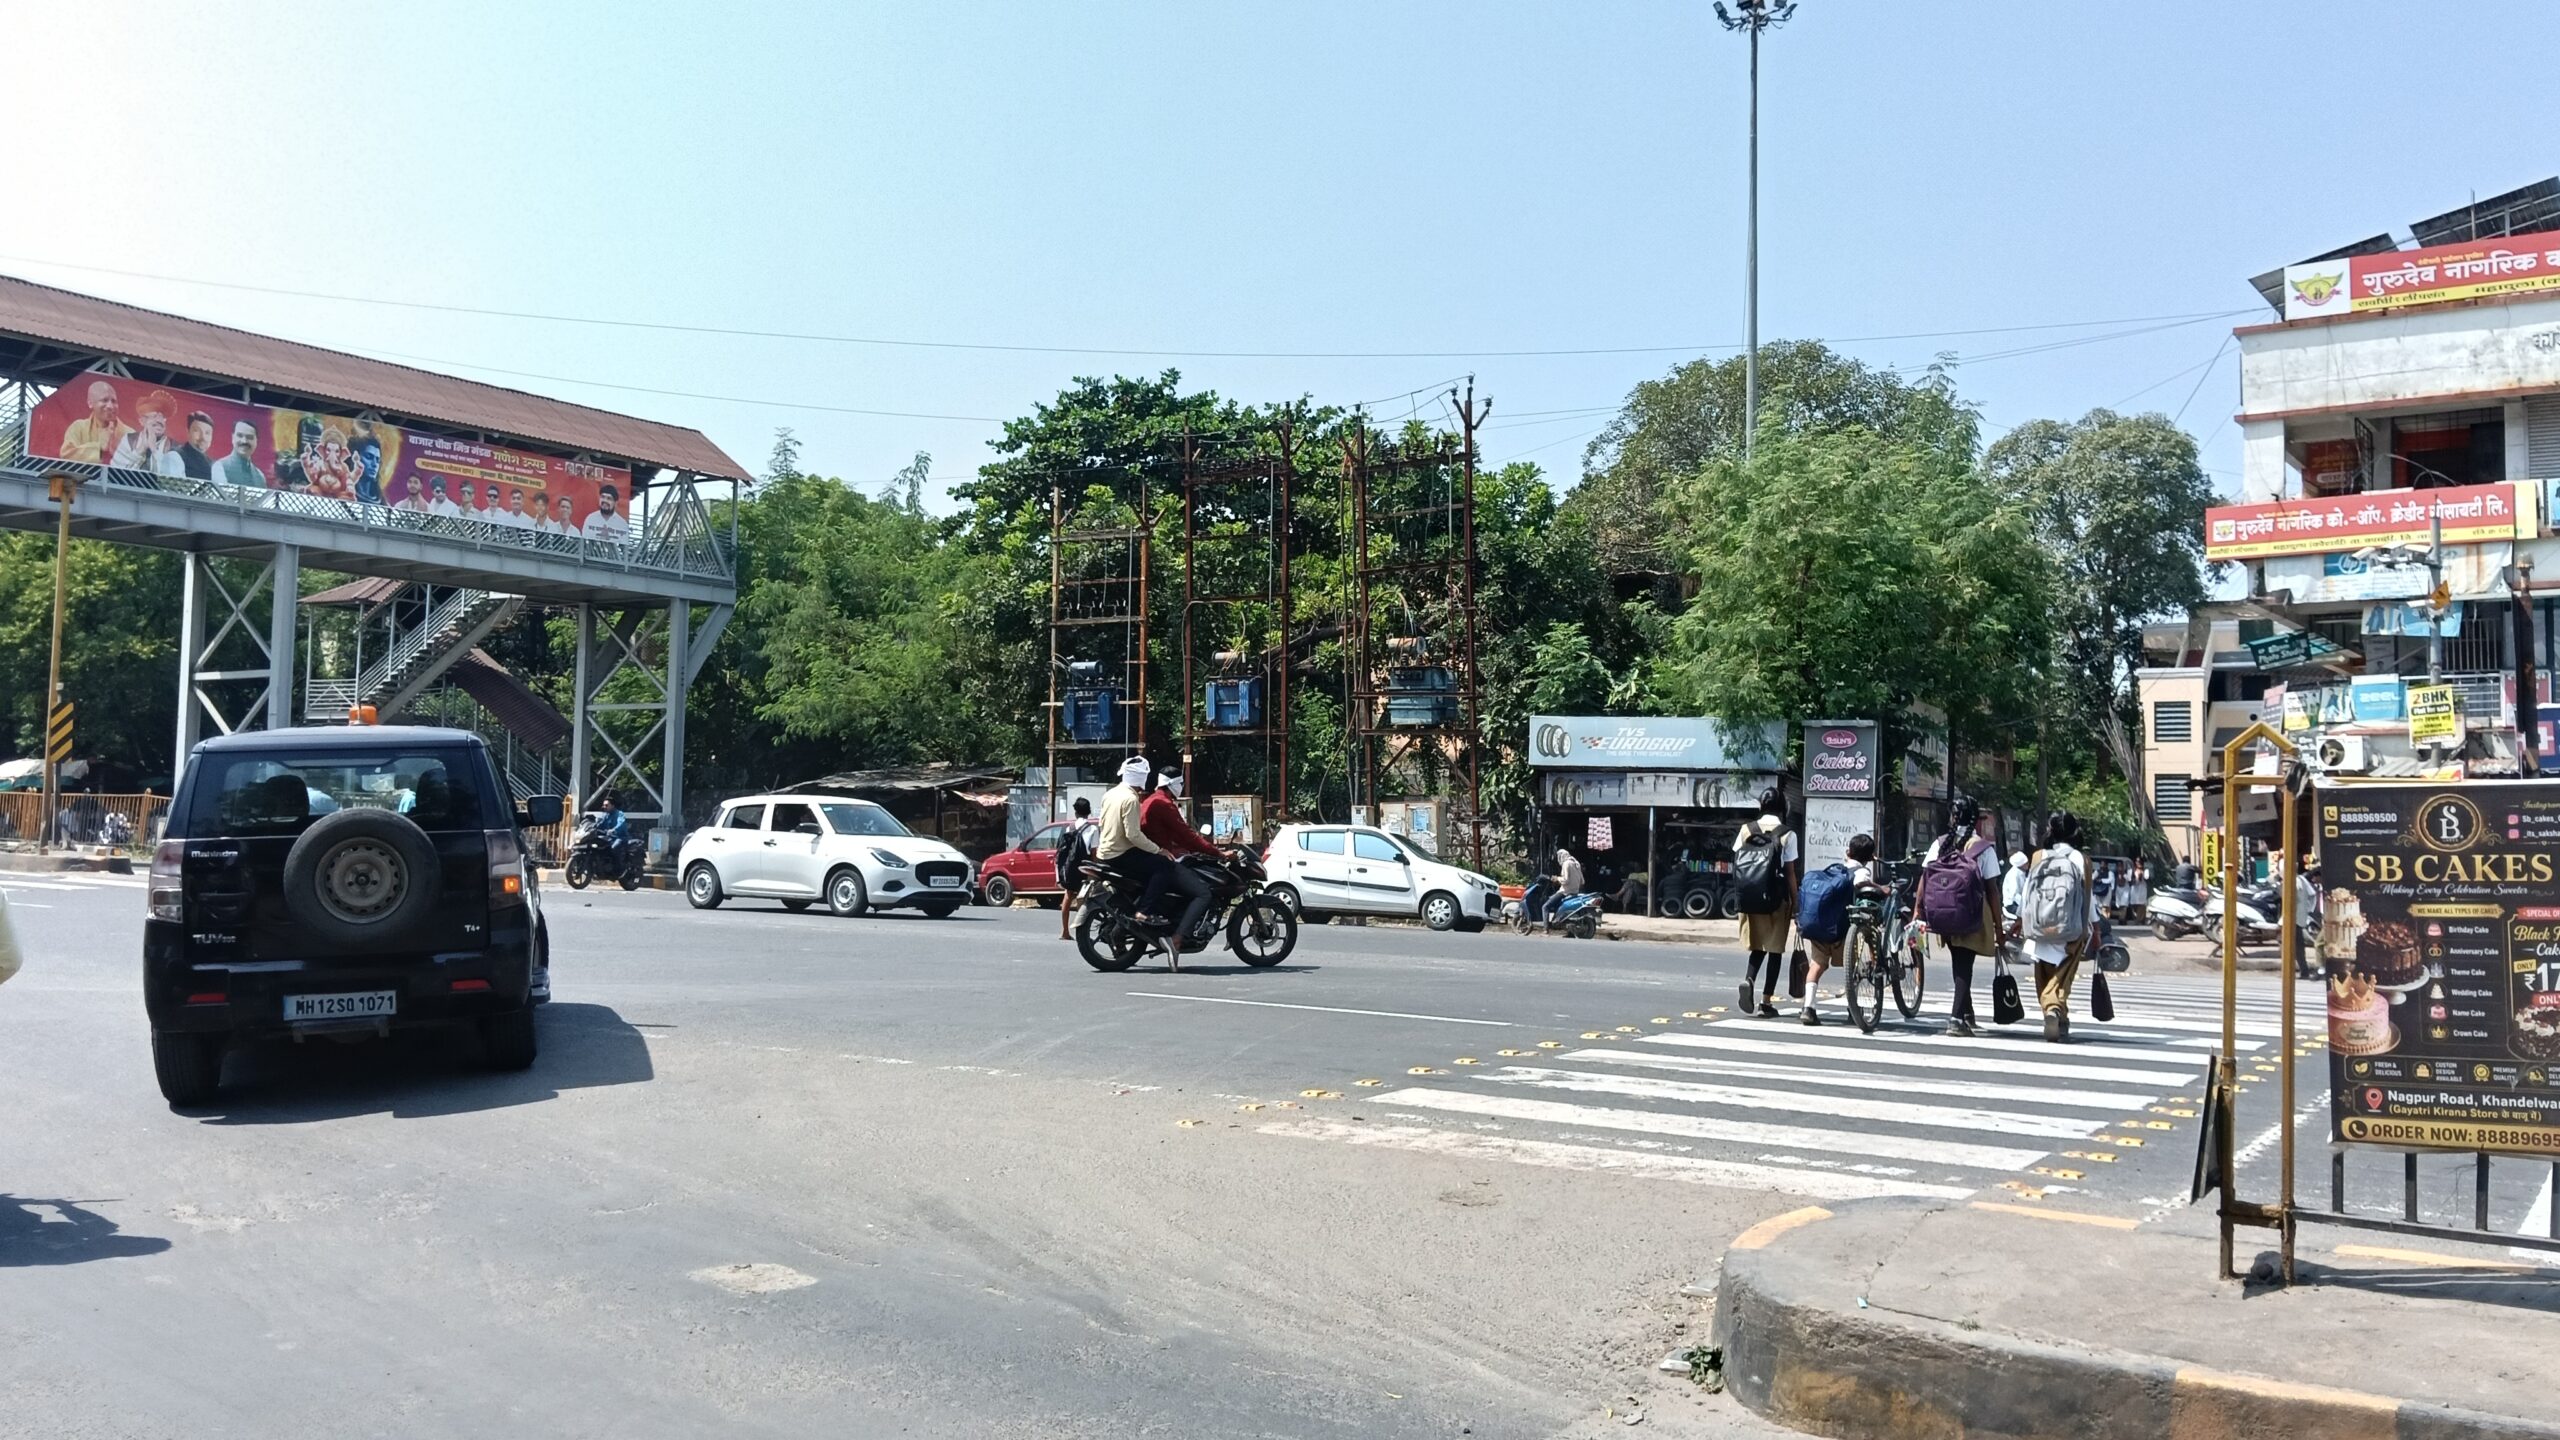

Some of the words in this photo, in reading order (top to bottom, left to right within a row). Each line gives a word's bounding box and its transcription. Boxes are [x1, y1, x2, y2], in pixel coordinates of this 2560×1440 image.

[2362, 262, 2437, 296] गुरुदेव
[2444, 250, 2538, 279] नागरिक
[408, 434, 434, 448] बाजार
[435, 437, 453, 450] चौक
[453, 440, 471, 454] मित्र
[492, 450, 520, 466] गणेश
[2236, 513, 2275, 541] गुरुदेव
[2277, 509, 2324, 532] नागरिक
[2486, 494, 2509, 516] लि.
[1617, 727, 1646, 737] TVS
[1595, 736, 1696, 752] EUROGRIP
[1813, 750, 1867, 769] Cake's
[1807, 773, 1870, 791] Station
[2341, 813, 2398, 823] 8888969500
[1822, 820, 1830, 833] 9
[1832, 820, 1858, 833] Sun's
[1809, 834, 1832, 846] Cake
[2354, 854, 2404, 882] SB
[2414, 853, 2554, 882] CAKES
[2380, 883, 2415, 897] Making
[2416, 882, 2442, 897] Every
[2443, 881, 2491, 896] Celebration
[2493, 884, 2529, 896] Sweeter
[2526, 909, 2552, 918] SPECIAL
[2448, 925, 2474, 935] Birthday
[2474, 926, 2489, 934] Cake
[2513, 925, 2551, 941] Black
[2450, 947, 2483, 957] Anniversary
[2451, 968, 2470, 976] Theme
[2516, 962, 2534, 970] ONLY
[2451, 988, 2477, 998] Wedding
[2478, 989, 2493, 997] Cake
[2452, 1009, 2470, 1017] Name
[2453, 1029, 2472, 1037] Crown
[2473, 1030, 2488, 1038] Cake
[2388, 1090, 2436, 1105] Nagpur
[2439, 1093, 2479, 1106] Road,
[2482, 1094, 2560, 1109] Khandelwa
[2389, 1104, 2431, 1116] (Gayatri
[2433, 1107, 2467, 1117] Kirana
[2470, 1108, 2498, 1119] Store
[2371, 1124, 2425, 1139] ORDER
[2430, 1128, 2473, 1143] NOW:
